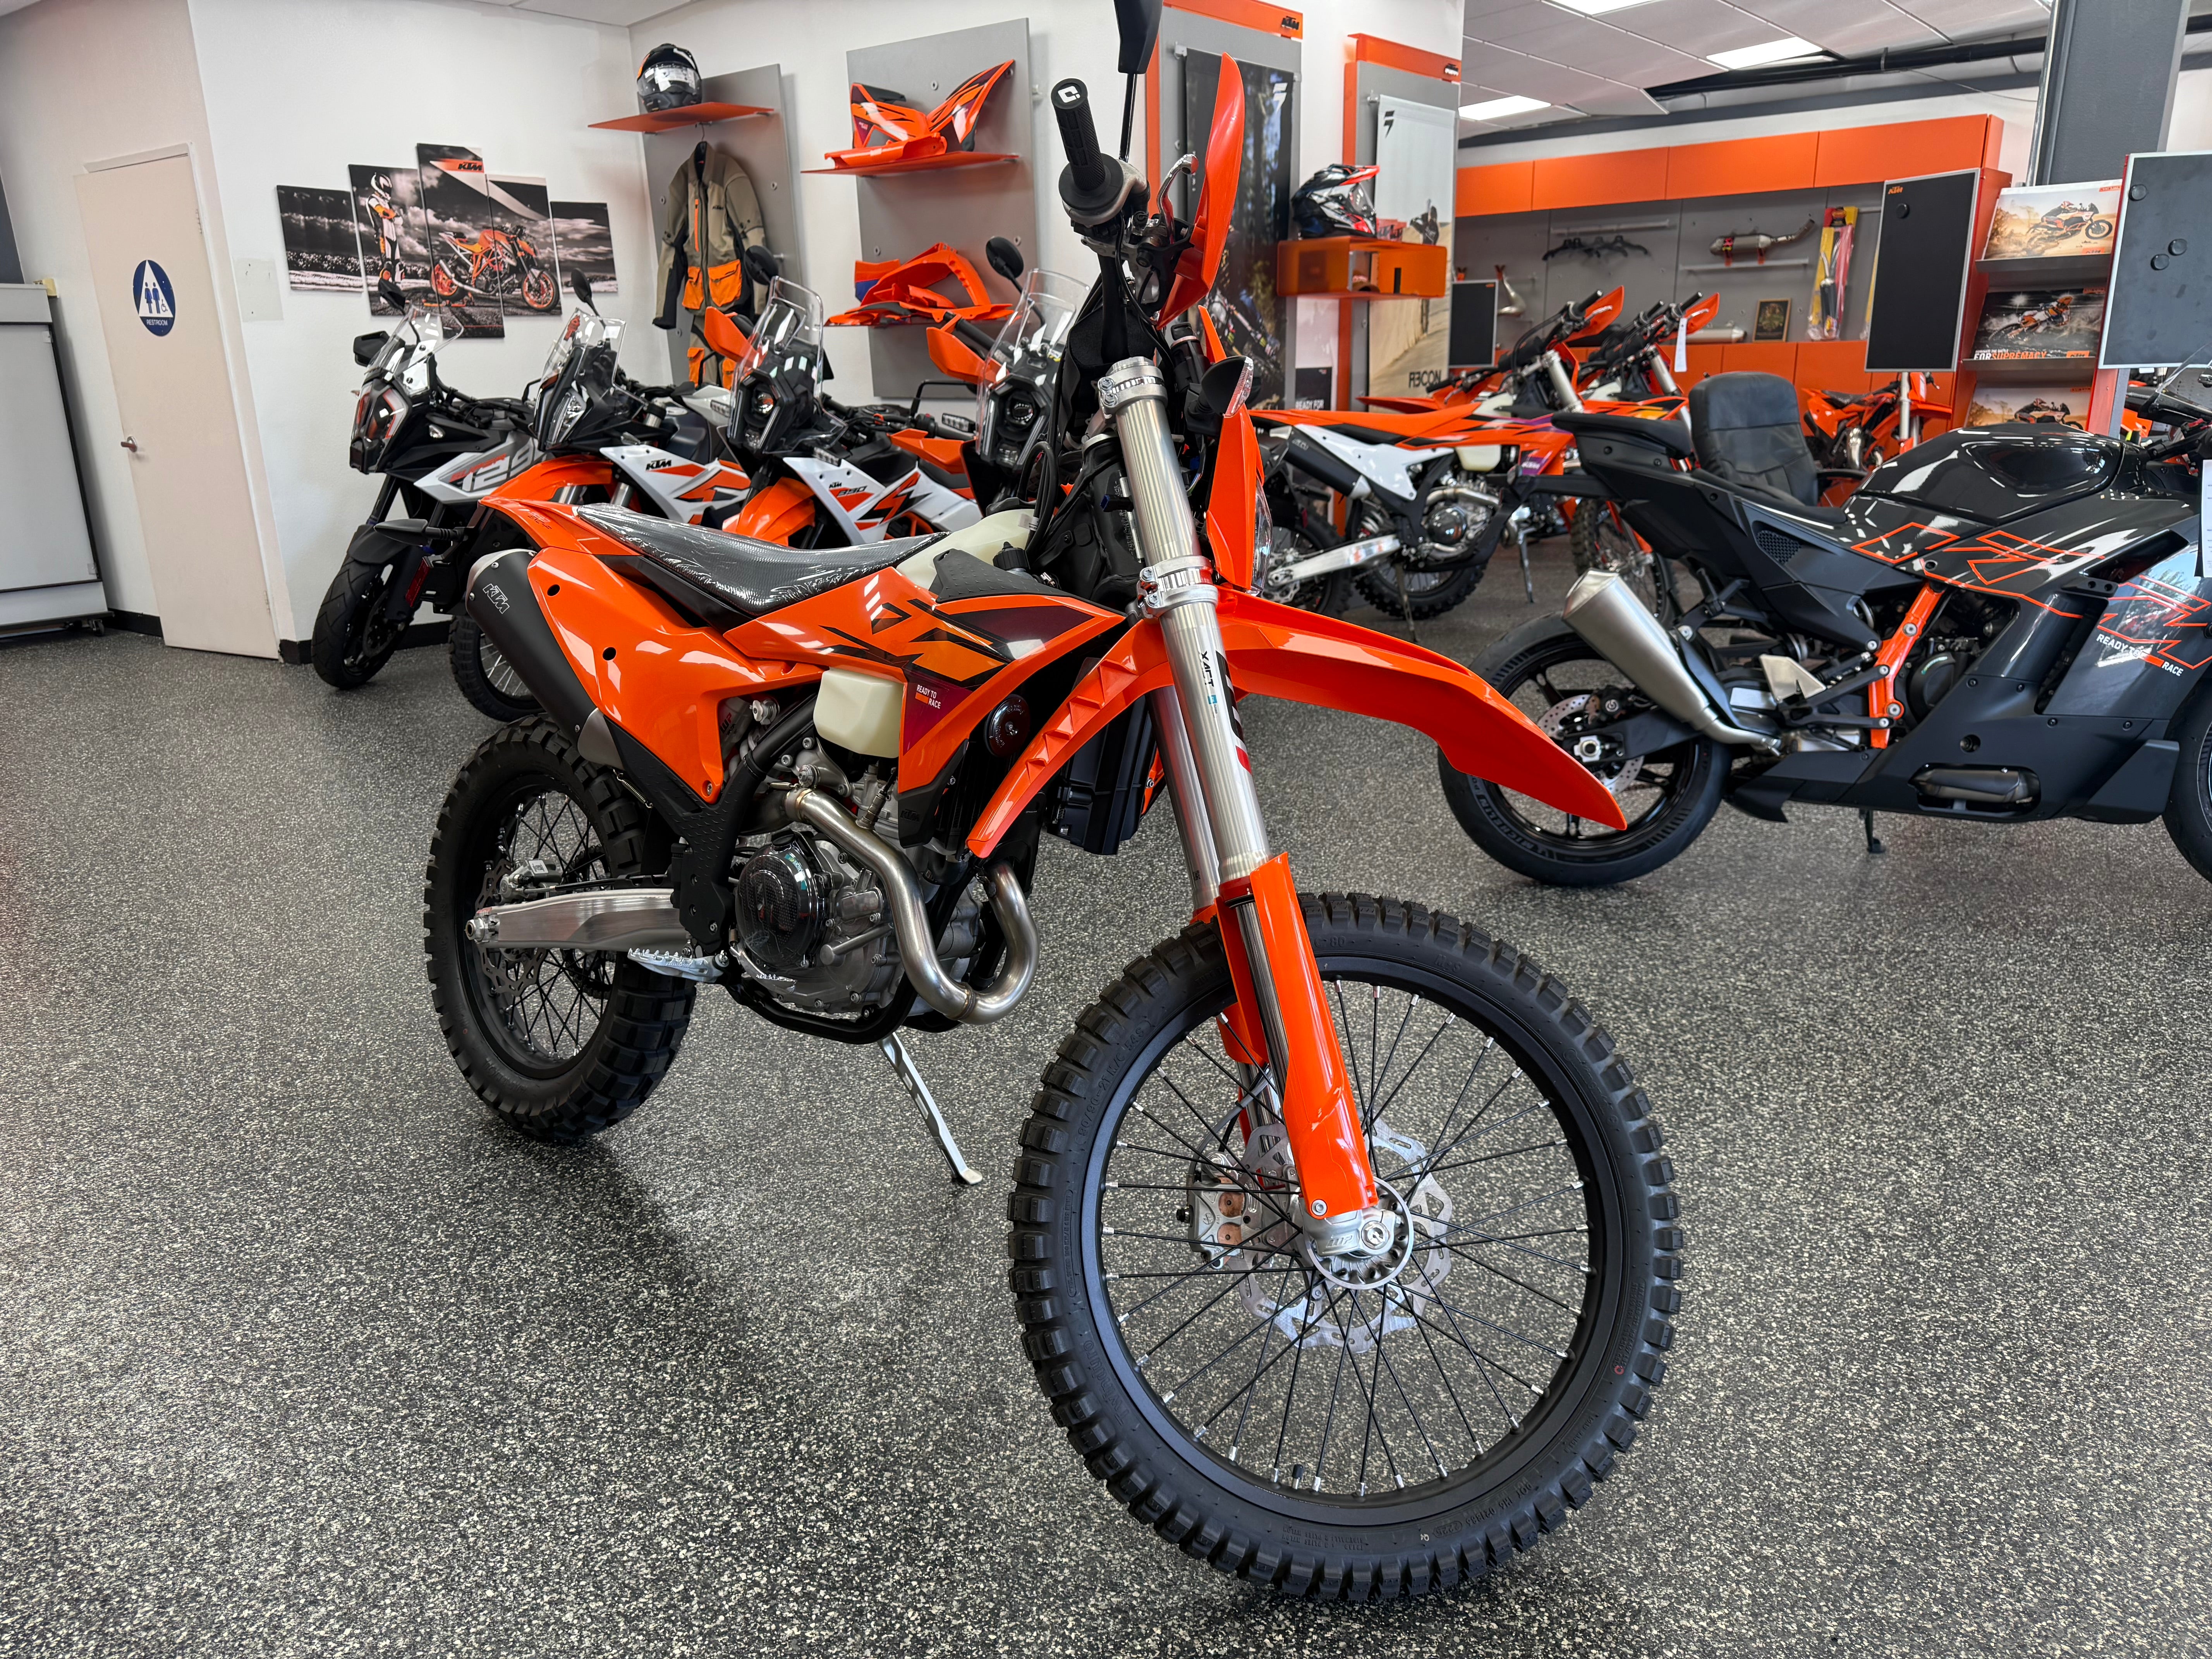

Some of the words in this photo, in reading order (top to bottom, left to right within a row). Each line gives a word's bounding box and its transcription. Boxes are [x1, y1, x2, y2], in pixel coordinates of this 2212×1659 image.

[458, 161, 483, 171] KTM
[646, 459, 672, 471] KTM
[483, 583, 510, 614] KTM
[2096, 634, 2128, 652] READY
[2129, 646, 2141, 658] TO
[2162, 661, 2184, 677] RACE
[917, 684, 931, 696] READY
[931, 690, 937, 699] TO
[928, 698, 941, 709] RACE
[1476, 794, 1539, 851] MICHELIN
[1515, 1481, 1534, 1499] DOT
